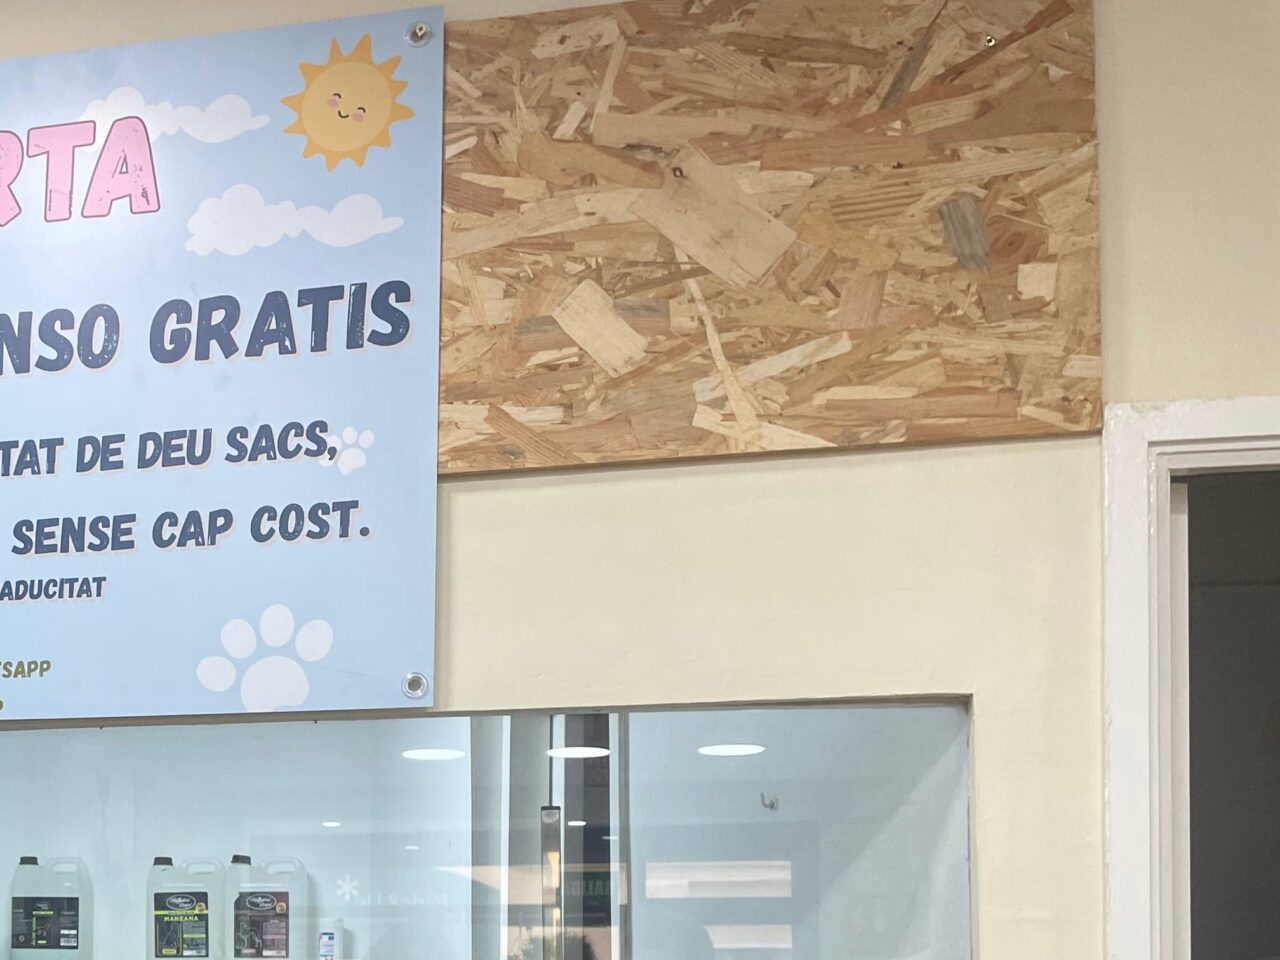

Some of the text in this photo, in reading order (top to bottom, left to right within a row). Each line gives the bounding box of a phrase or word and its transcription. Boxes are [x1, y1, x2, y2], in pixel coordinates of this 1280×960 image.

[150, 280, 412, 364] GRATIS
[76, 433, 125, 471] DE
[138, 428, 211, 467] DEU
[225, 419, 339, 463] SACS,
[11, 514, 136, 556] SENSE
[152, 508, 233, 548] CAP
[250, 500, 370, 543] COST.
